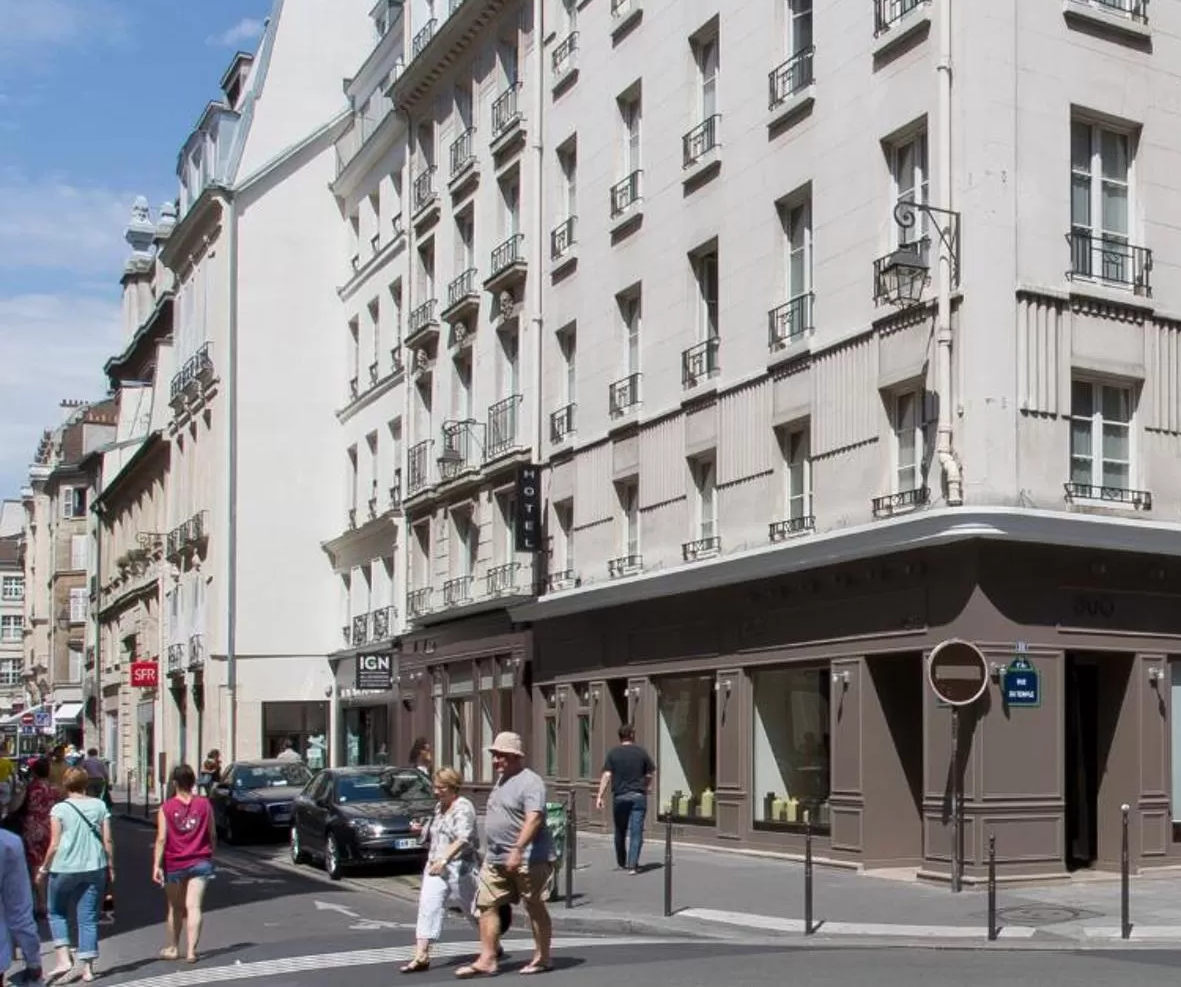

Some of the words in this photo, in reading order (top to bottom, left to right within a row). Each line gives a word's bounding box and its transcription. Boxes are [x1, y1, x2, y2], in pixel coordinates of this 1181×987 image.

[523, 469, 535, 548] HOTEL
[360, 656, 390, 670] IGN
[134, 668, 156, 681] SFR
[1017, 690, 1035, 698] TEMPLE
